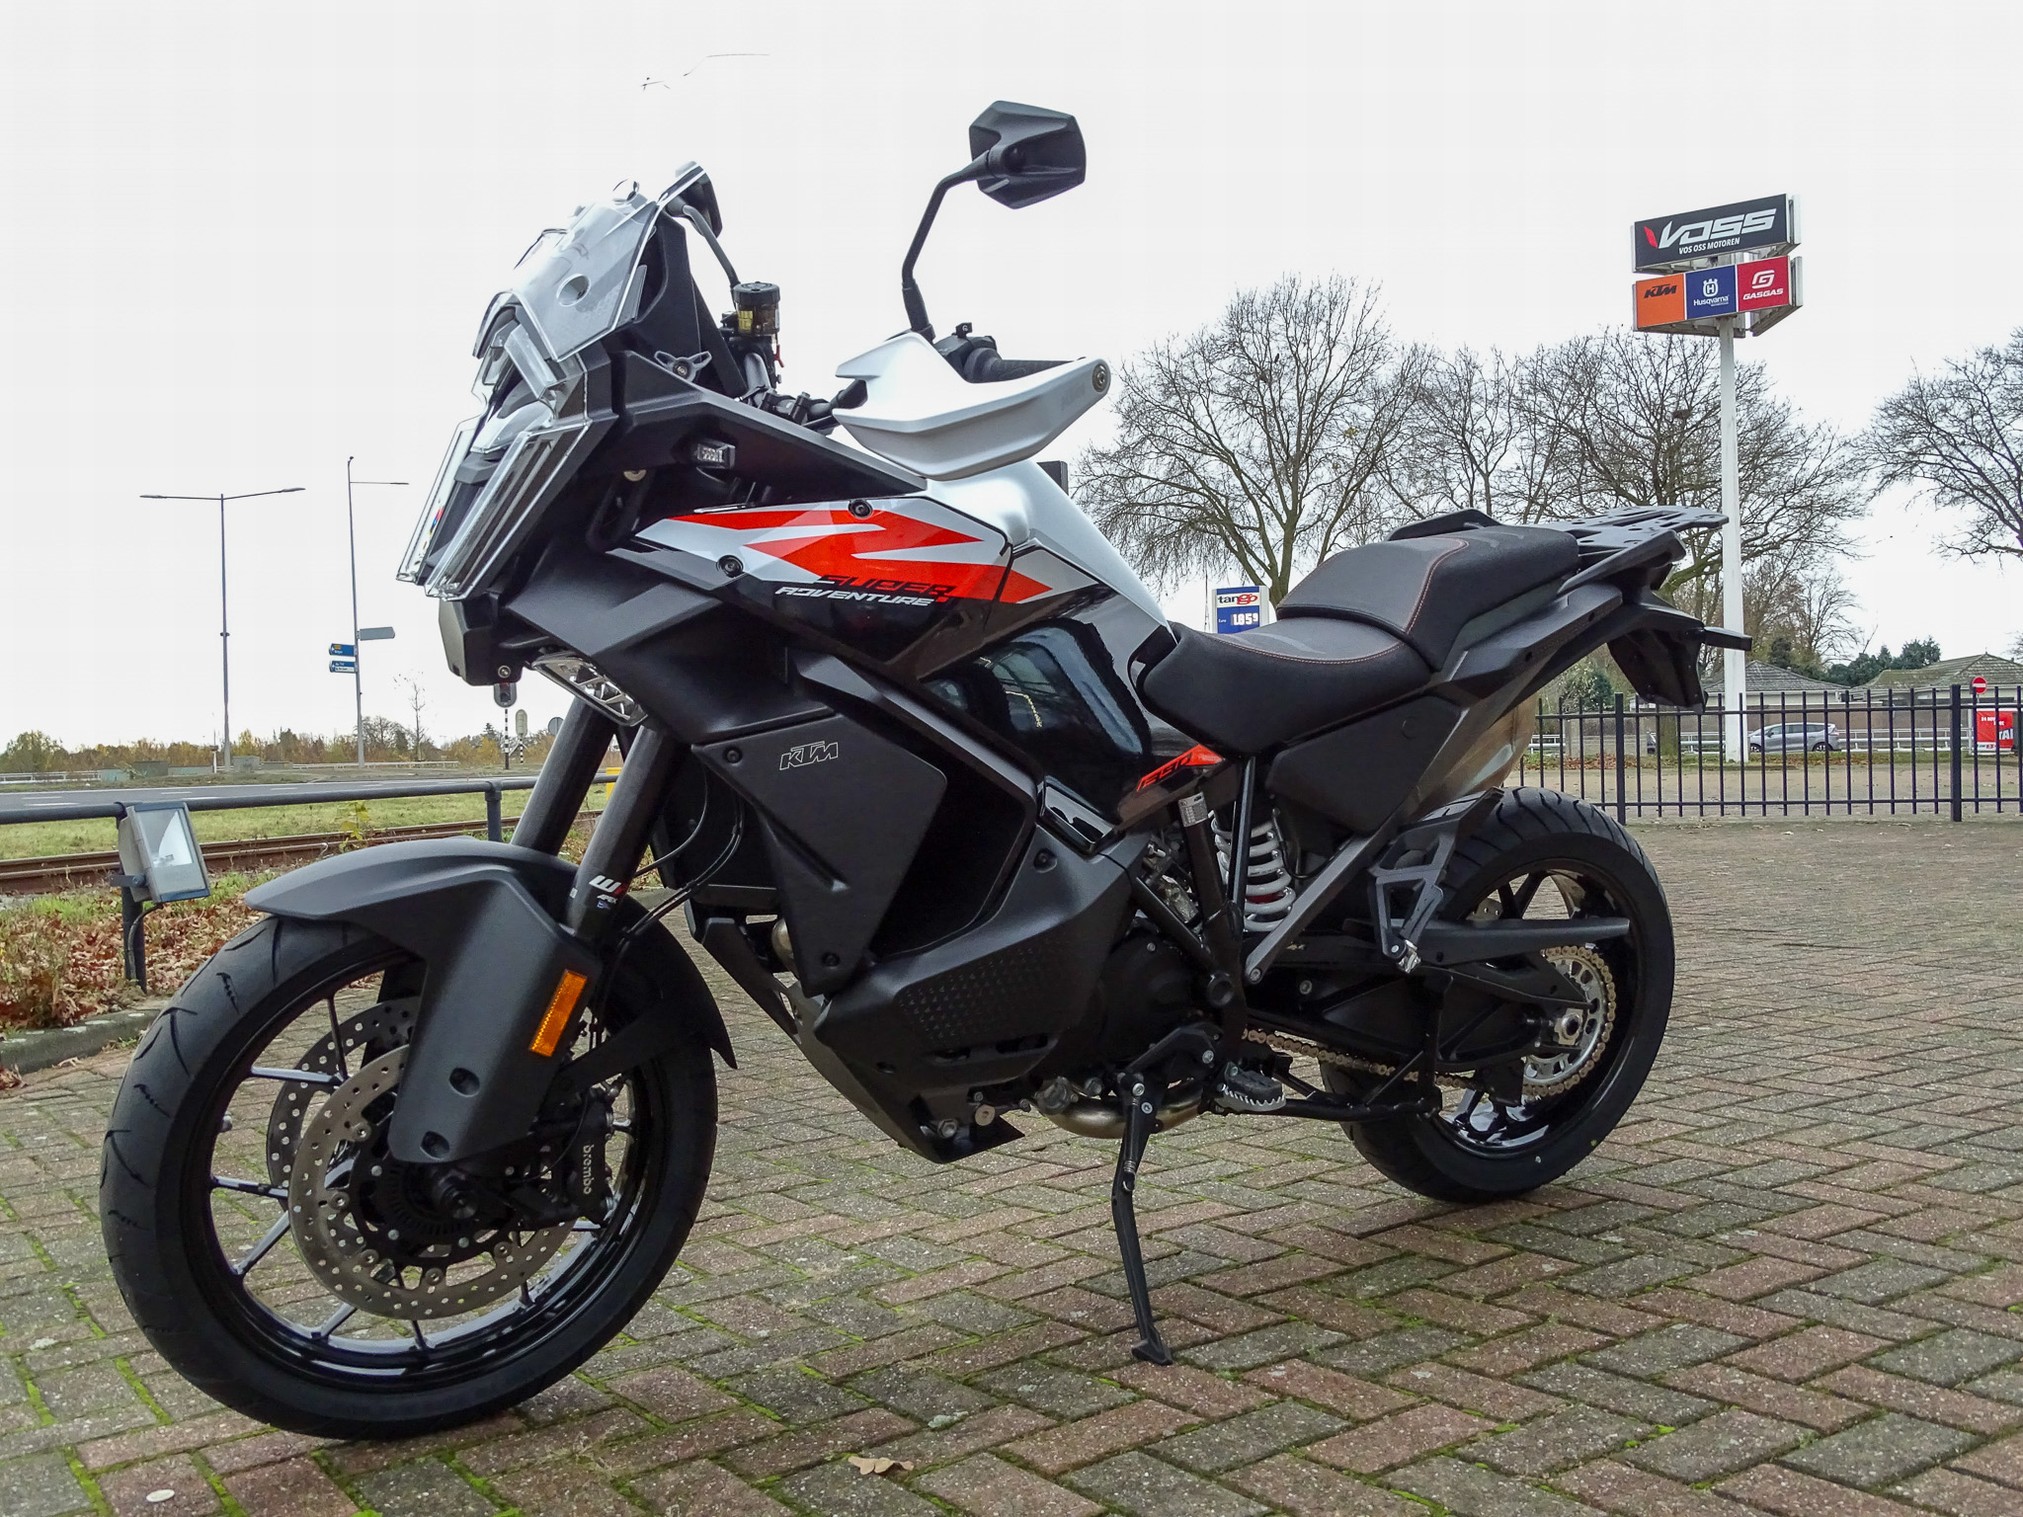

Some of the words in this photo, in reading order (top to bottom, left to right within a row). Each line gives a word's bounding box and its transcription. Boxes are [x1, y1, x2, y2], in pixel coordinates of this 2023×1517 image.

[1646, 208, 1777, 249] VOSS
[1679, 246, 1693, 255] VOS
[1693, 243, 1707, 253] OSS
[1707, 237, 1741, 250] MOTOREN
[1643, 284, 1678, 299] KTM
[1742, 287, 1784, 300] GASGAS
[1693, 295, 1729, 307] Husqvarna
[775, 586, 934, 607] ADVENTURE
[1218, 593, 1258, 605] tango
[779, 740, 839, 771] KTM
[583, 1144, 595, 1195] brembo
